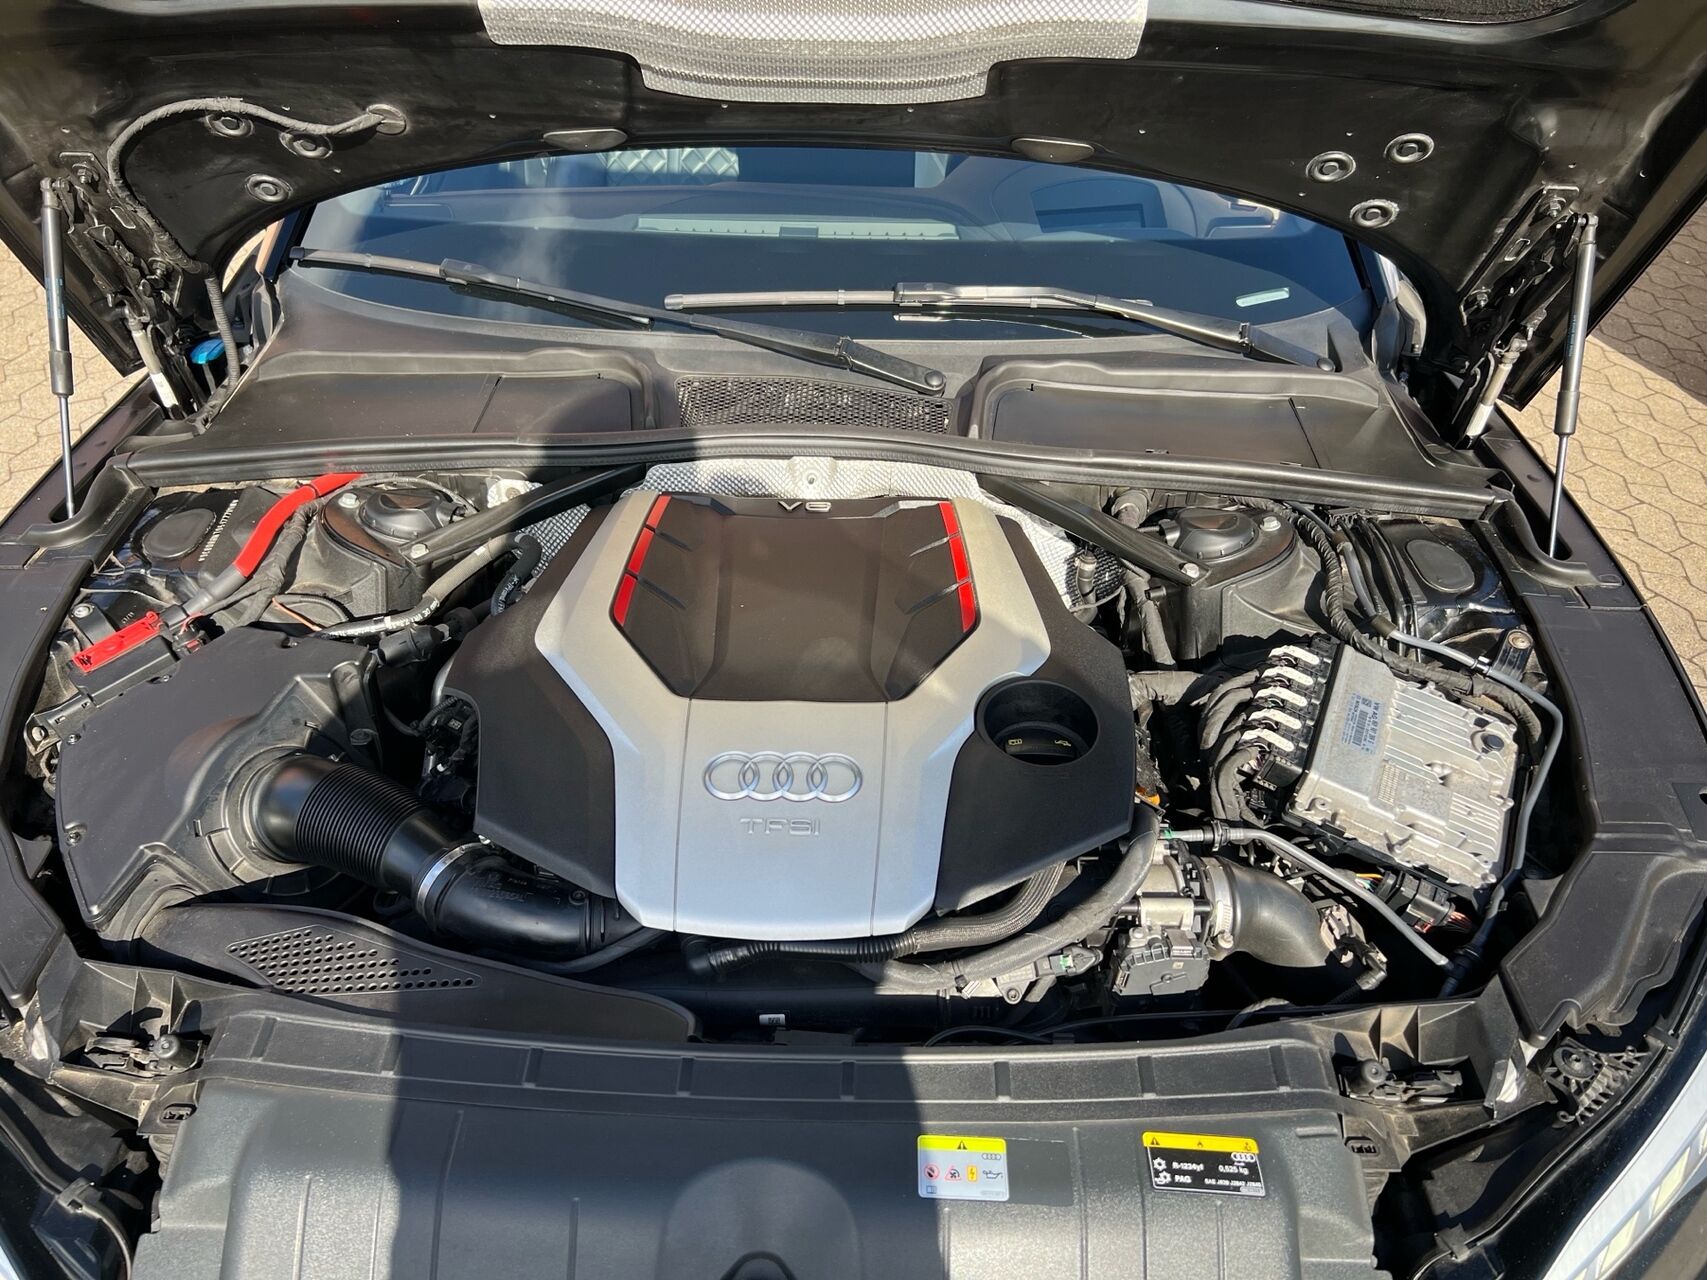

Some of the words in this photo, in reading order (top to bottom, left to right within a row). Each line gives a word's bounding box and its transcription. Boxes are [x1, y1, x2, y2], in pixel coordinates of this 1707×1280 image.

[778, 500, 831, 512] V6
[740, 818, 820, 835] TFSI
[1239, 1167, 1249, 1176] kg
[1174, 1174, 1192, 1183] PAG
